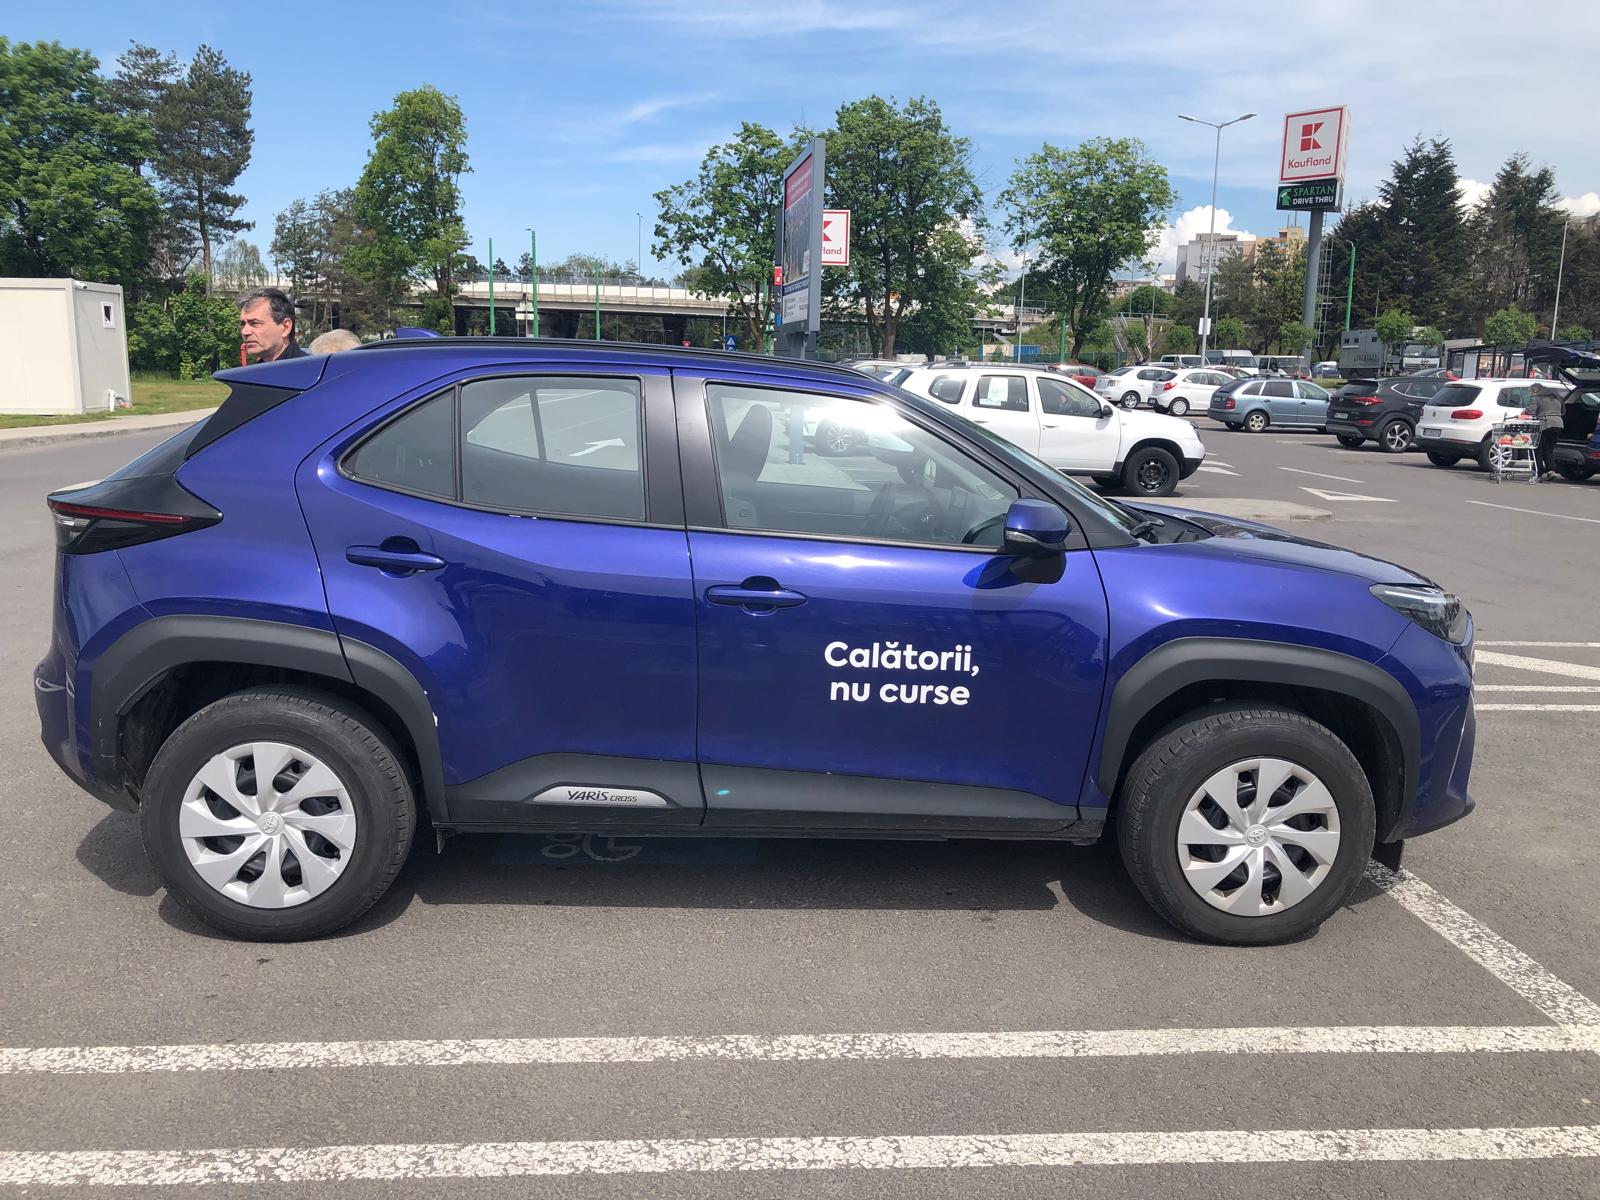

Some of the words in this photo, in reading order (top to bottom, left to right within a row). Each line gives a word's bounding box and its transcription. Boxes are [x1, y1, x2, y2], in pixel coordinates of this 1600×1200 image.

[1287, 155, 1332, 169] Kaufland
[1293, 185, 1335, 197] SPARTAN
[1292, 197, 1313, 205] DRIVE
[1315, 195, 1334, 203] THRU
[823, 246, 842, 255] land
[824, 641, 980, 677] Calătorii,
[830, 681, 870, 702] nu
[879, 683, 970, 706] curse
[609, 795, 638, 803] CROSS
